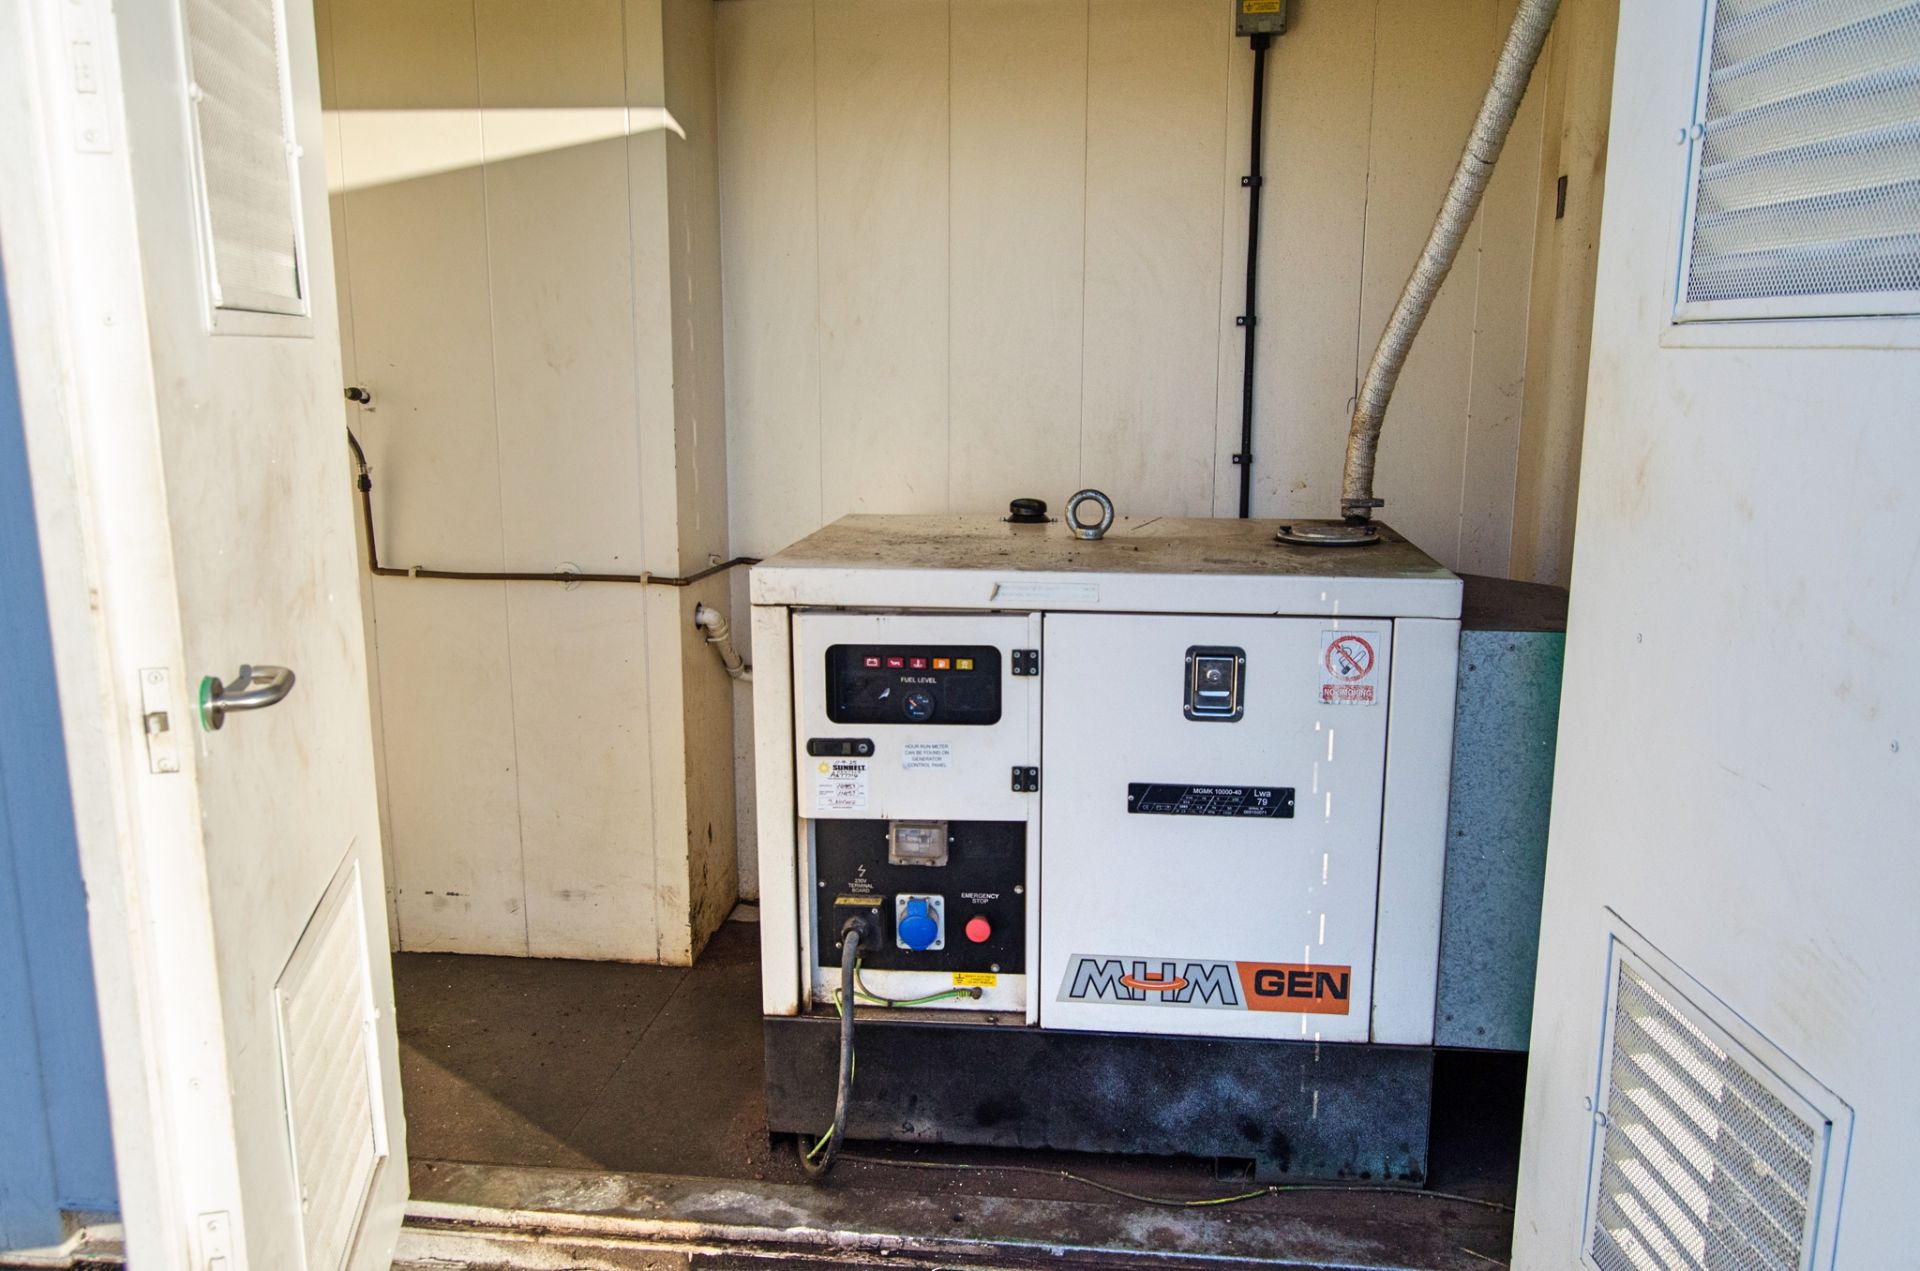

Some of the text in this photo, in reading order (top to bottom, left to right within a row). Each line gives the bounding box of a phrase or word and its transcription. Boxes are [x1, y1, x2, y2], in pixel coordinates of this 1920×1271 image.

[1323, 688, 1336, 697] NO
[1253, 789, 1272, 798] Lwa
[1257, 798, 1268, 806] 79
[1069, 958, 1349, 1006] MHM GEN
